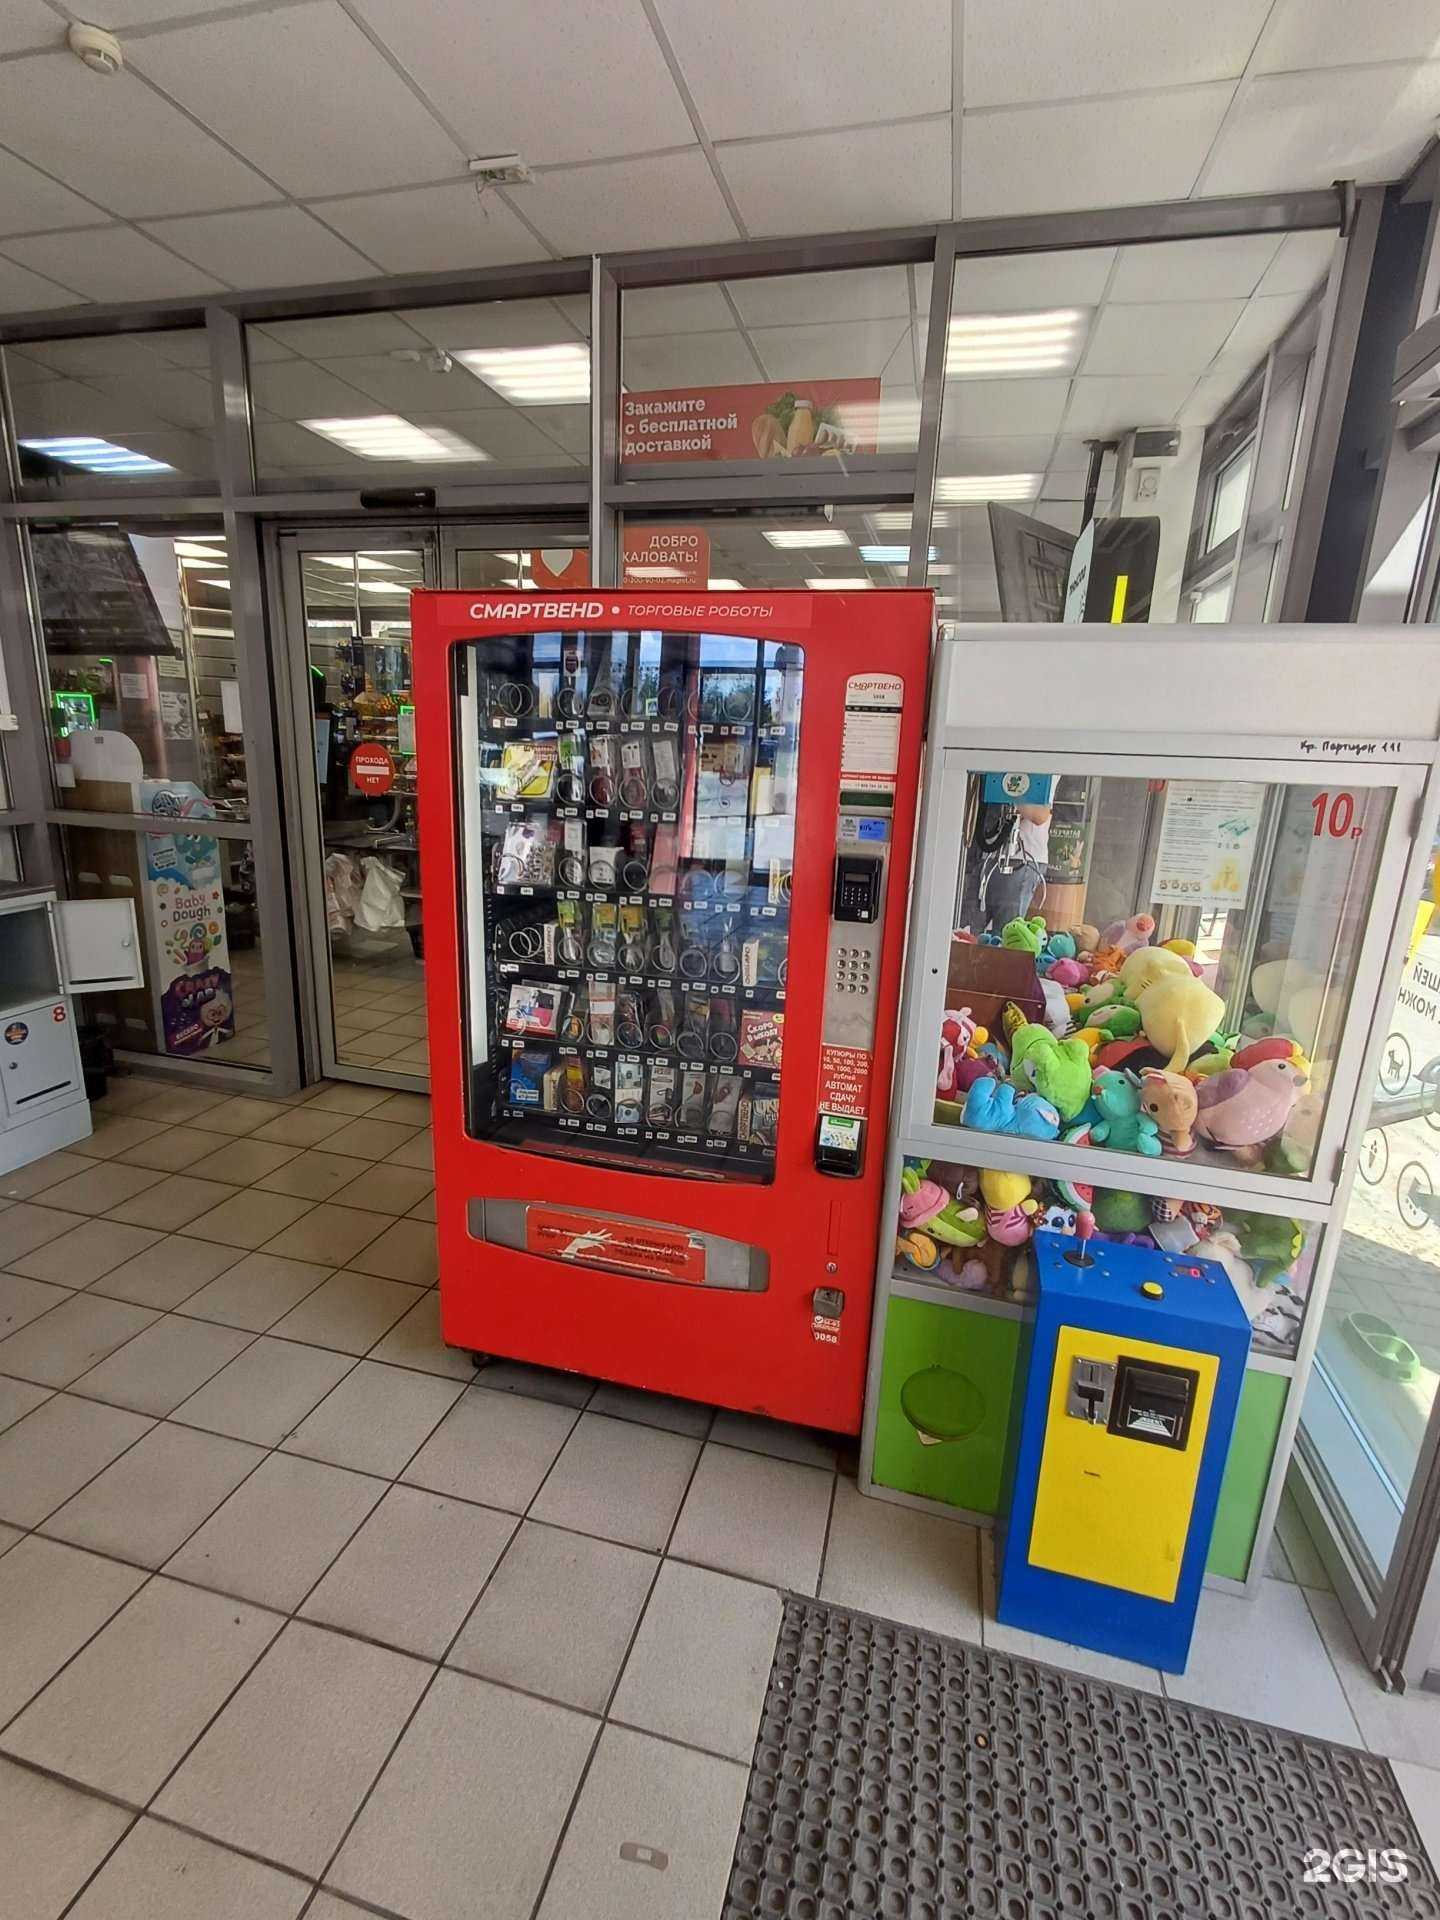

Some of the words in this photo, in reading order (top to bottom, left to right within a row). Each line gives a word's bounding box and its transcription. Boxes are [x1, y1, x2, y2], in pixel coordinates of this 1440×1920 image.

[624, 399, 706, 416] Закажите
[625, 424, 635, 435] с
[639, 413, 738, 434] бесплатной
[625, 434, 712, 456] доставкой
[649, 535, 698, 548] ДОБРО
[628, 605, 706, 616] ТОРГОВЫЕ
[708, 606, 774, 617] РОБОТЫ
[355, 756, 389, 764] ПРОХОДА
[175, 895, 206, 910] Baby
[173, 906, 211, 922] Dough
[53, 1006, 66, 1022] 8
[826, 1049, 856, 1059] КУПЮРЫ
[857, 1052, 867, 1060] ПО
[833, 1073, 856, 1081] рублей
[825, 1080, 862, 1092] АВТОМАТ
[830, 1092, 856, 1103] СДАЧУ
[819, 1101, 830, 1110] НЕ
[831, 1103, 865, 1115] ВЫДАЕТ
